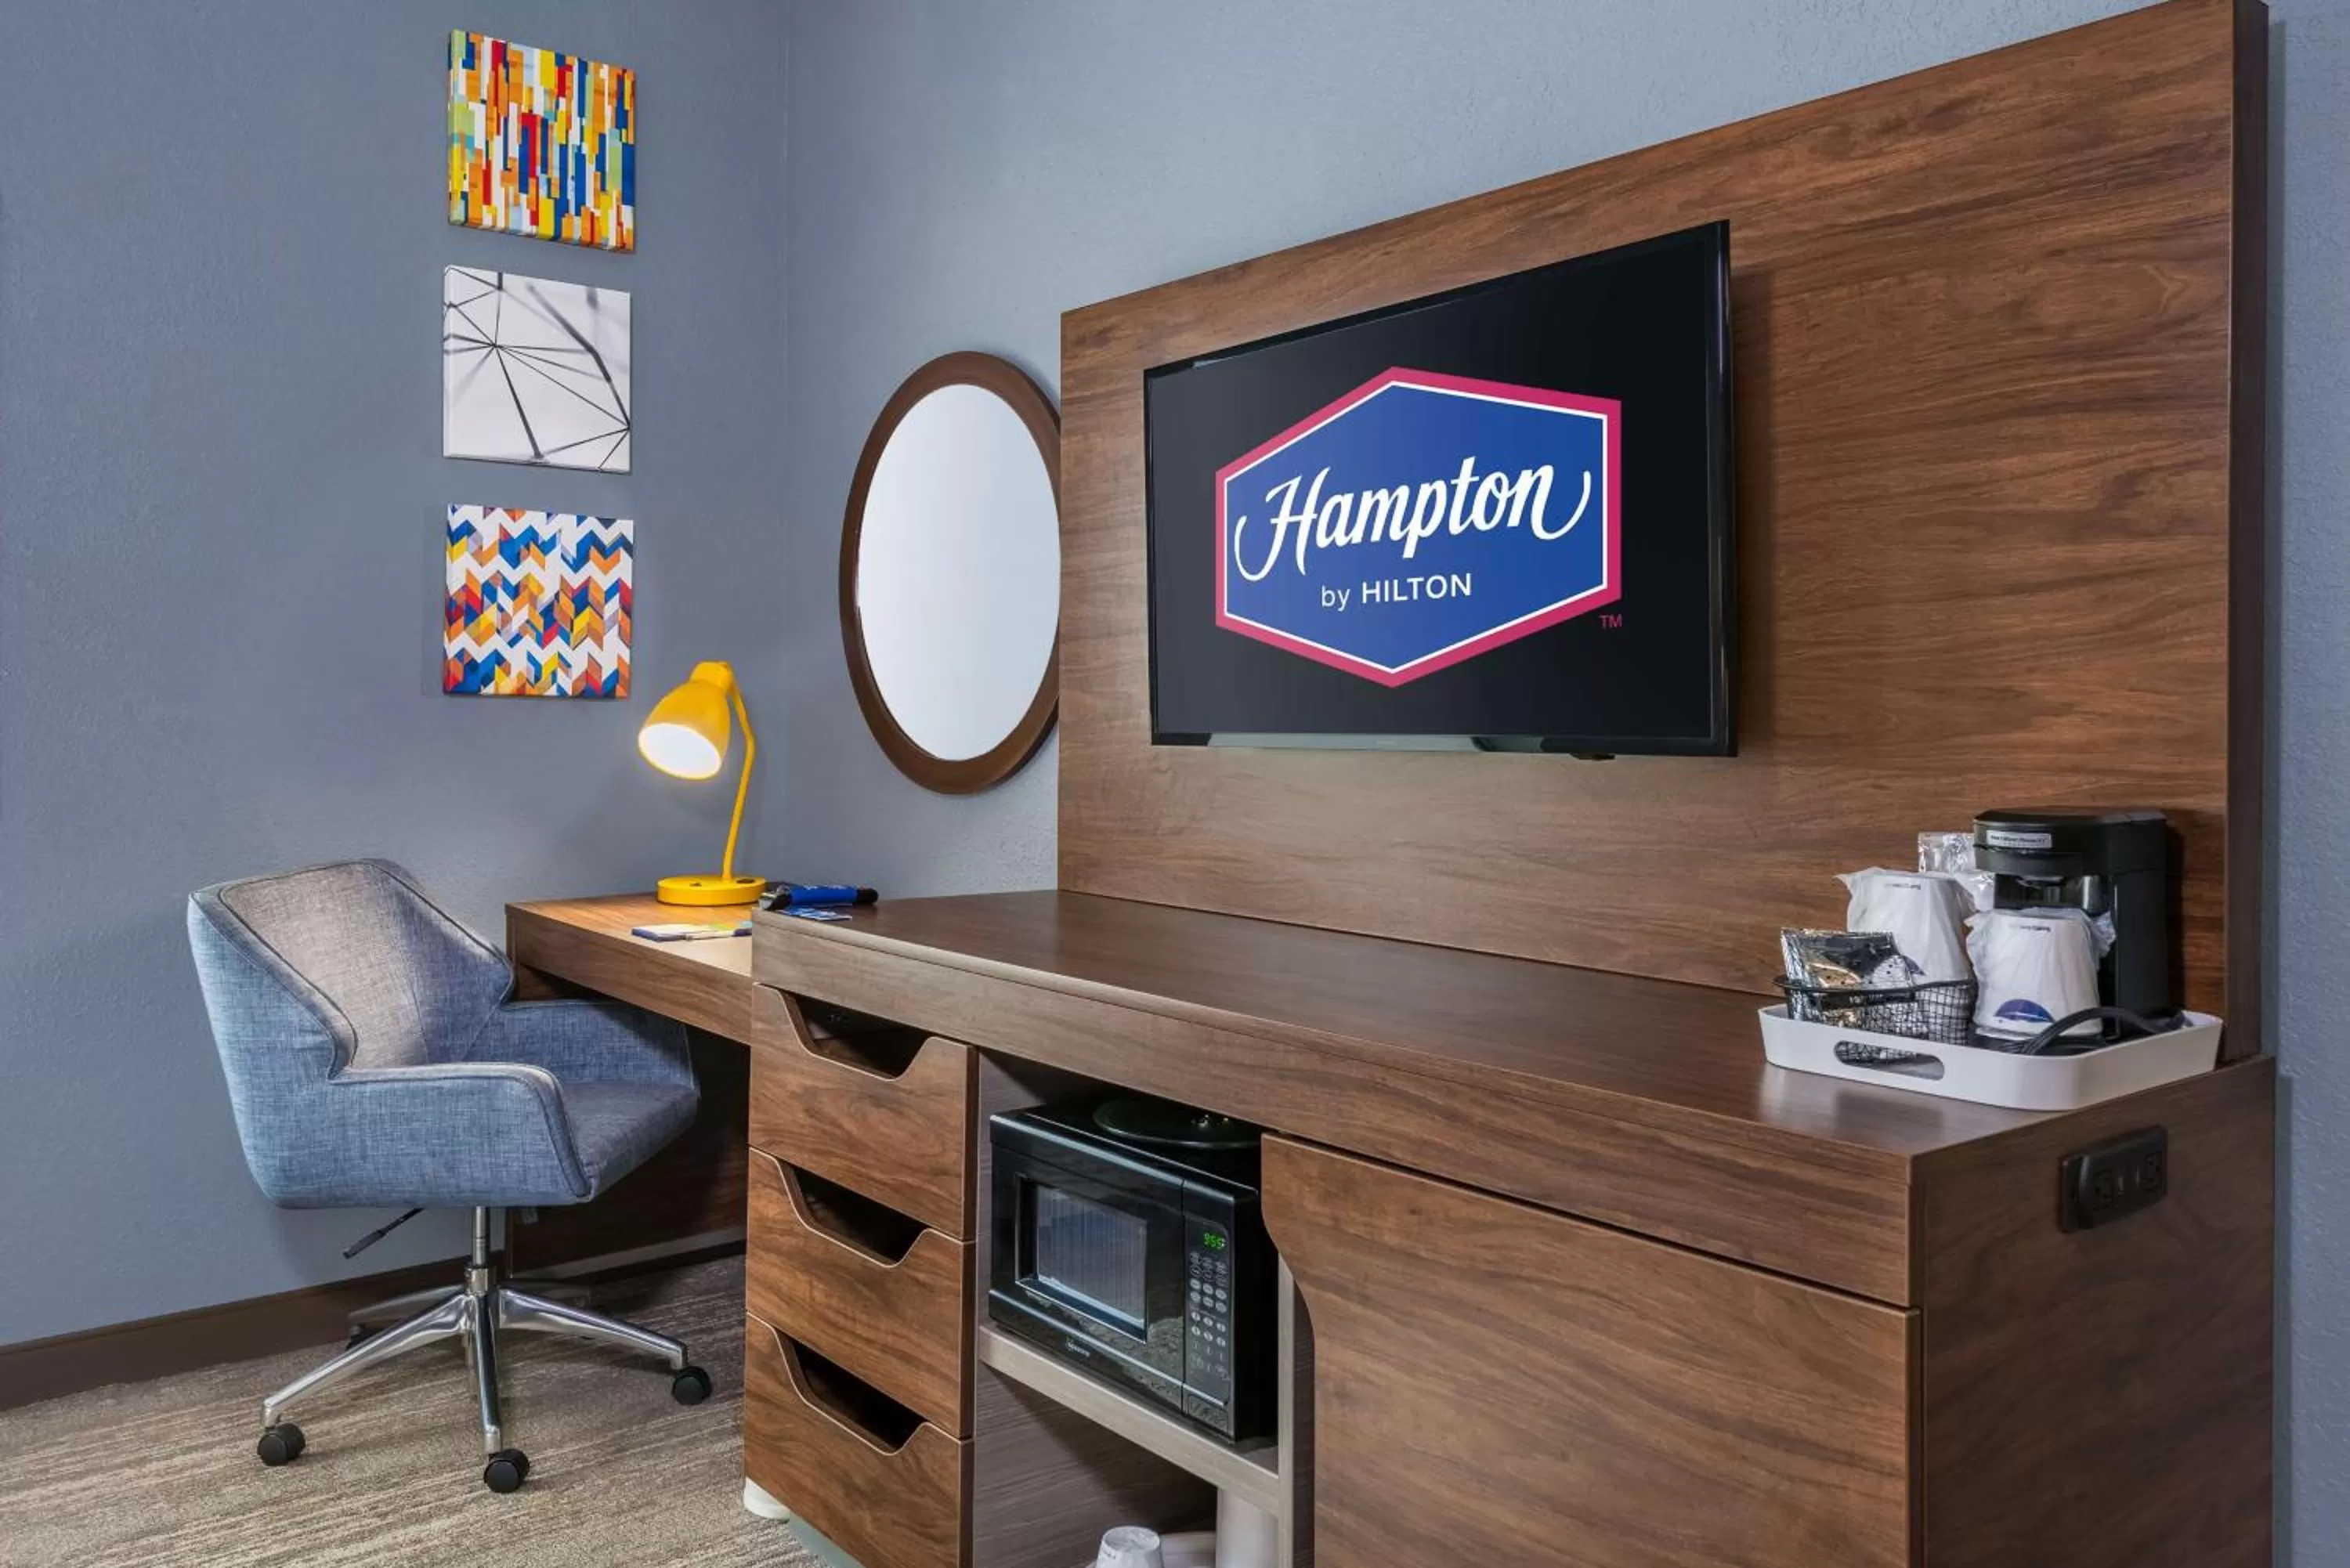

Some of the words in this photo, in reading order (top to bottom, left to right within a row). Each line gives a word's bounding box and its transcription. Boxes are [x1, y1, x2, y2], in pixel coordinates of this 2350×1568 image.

[1235, 457, 1591, 581] Hampton
[1321, 586, 1350, 612] by
[1362, 573, 1472, 604] HILTON
[1599, 614, 1622, 629] TM
